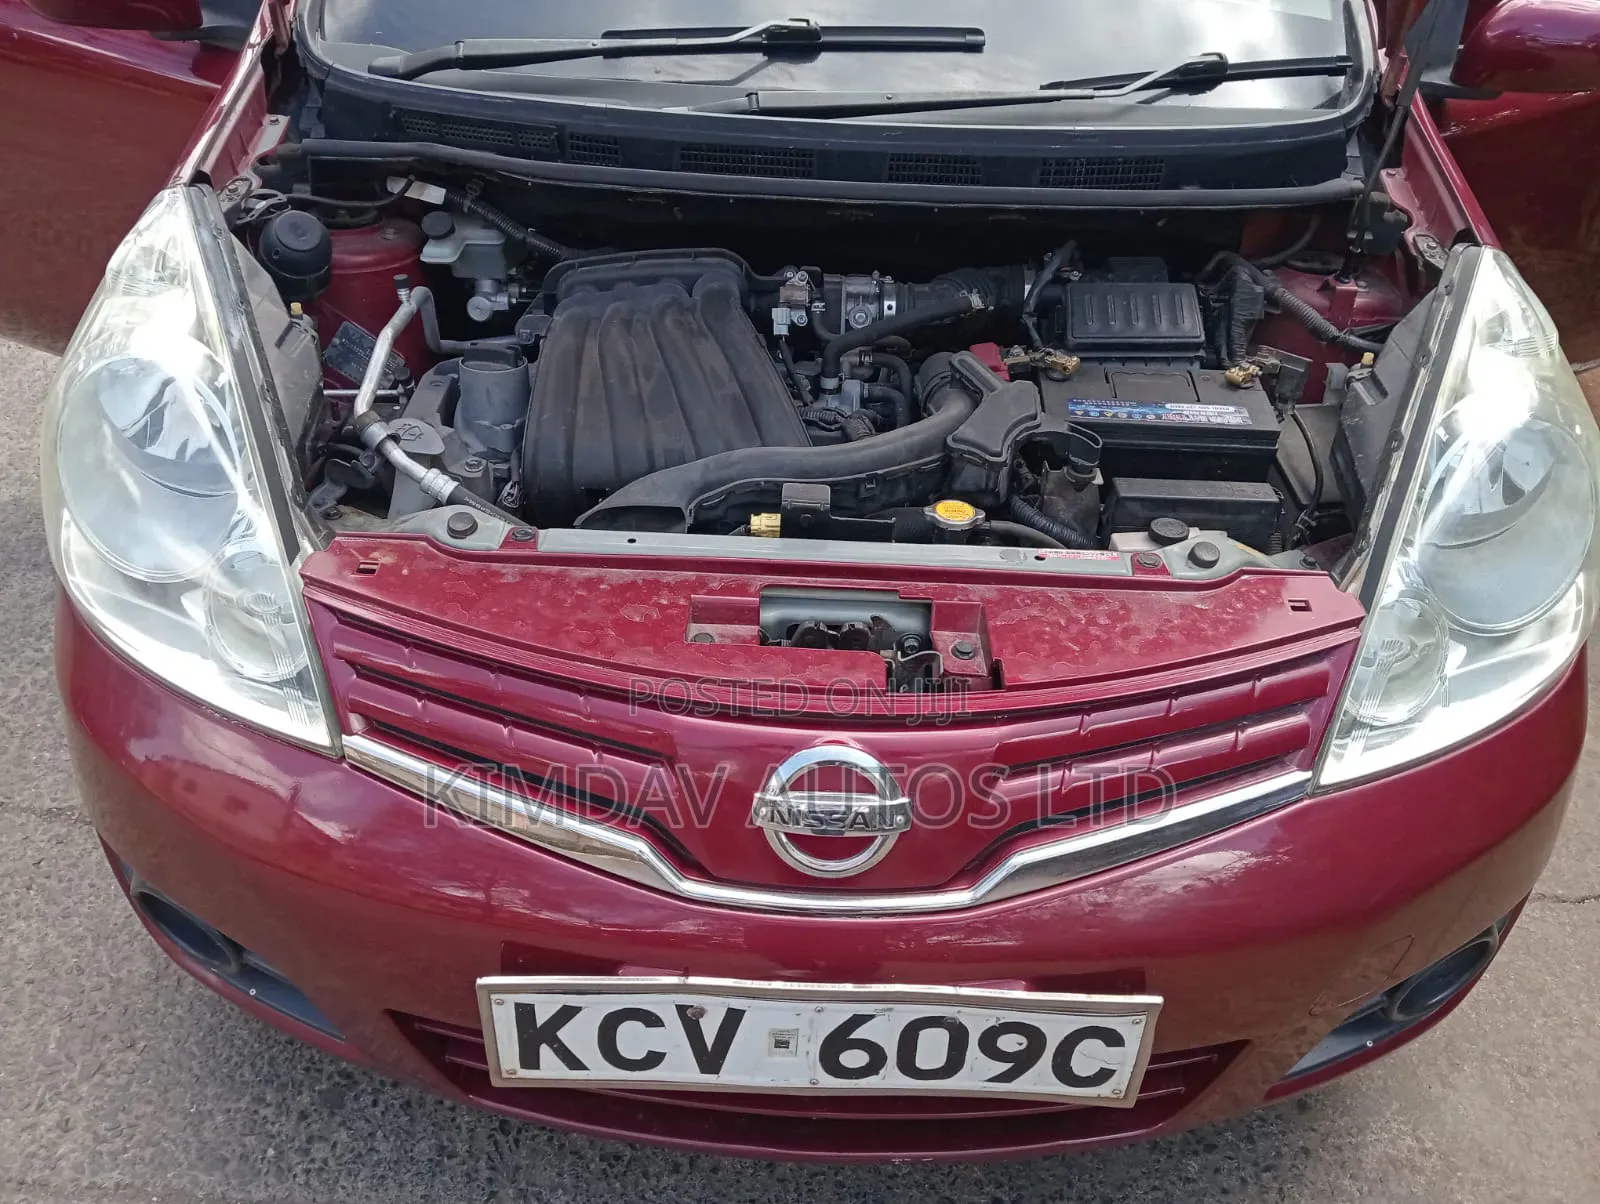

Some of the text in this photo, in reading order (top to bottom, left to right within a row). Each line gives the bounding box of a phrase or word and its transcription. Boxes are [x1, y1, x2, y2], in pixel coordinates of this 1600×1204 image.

[768, 804, 896, 830] NISSAN
[514, 1002, 1125, 1088] KCV 609C
